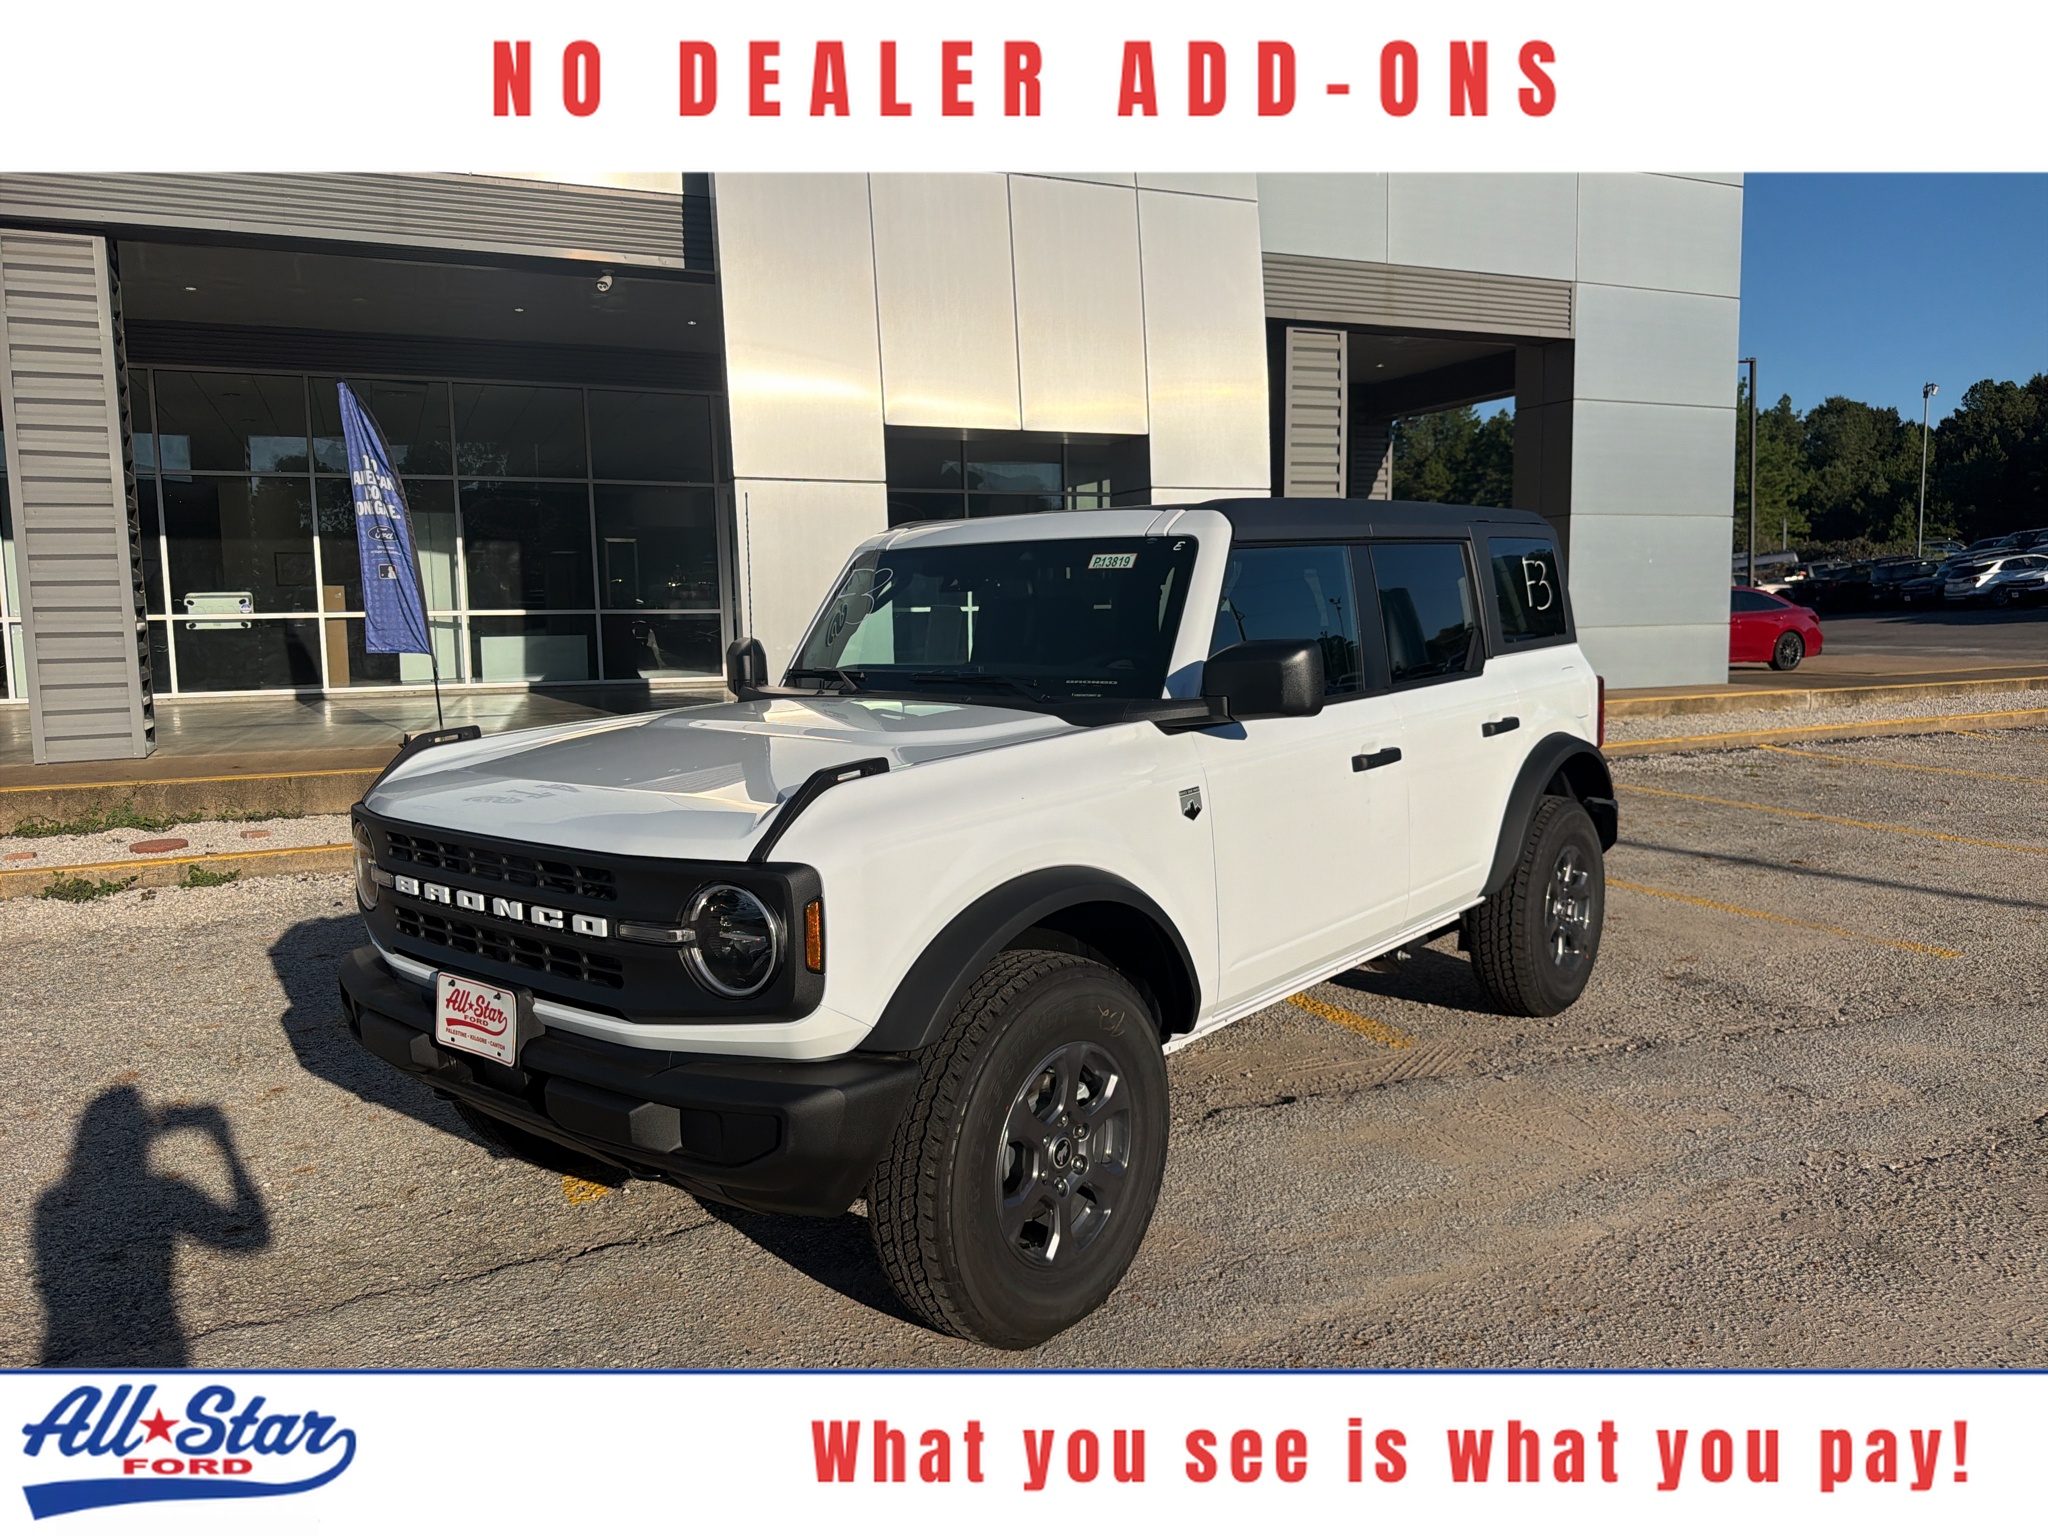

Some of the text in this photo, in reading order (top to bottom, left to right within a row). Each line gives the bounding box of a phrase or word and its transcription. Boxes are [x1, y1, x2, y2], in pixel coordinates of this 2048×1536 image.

[356, 501, 375, 516] ON
[394, 874, 608, 938] BRONCO
[445, 988, 508, 1024] All Star
[464, 1014, 489, 1027] FORD
[445, 1027, 506, 1051] PALESTINE KILGORE CANTON
